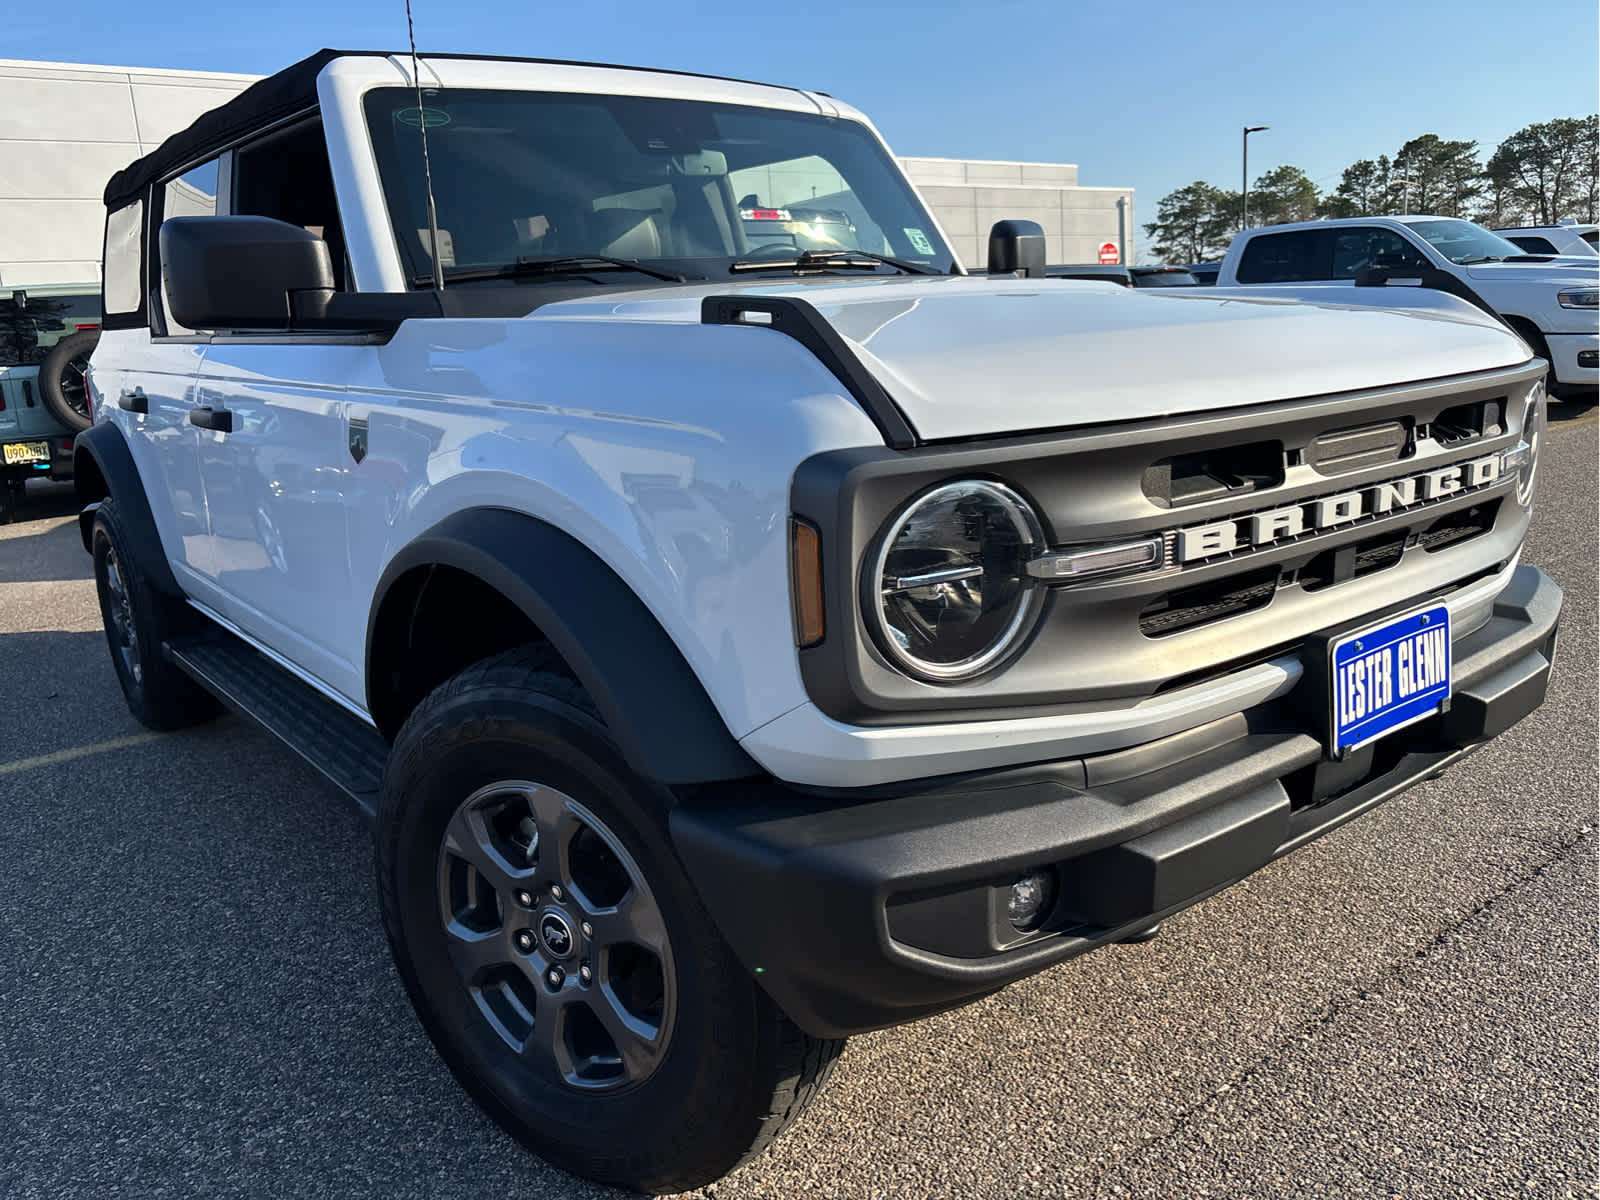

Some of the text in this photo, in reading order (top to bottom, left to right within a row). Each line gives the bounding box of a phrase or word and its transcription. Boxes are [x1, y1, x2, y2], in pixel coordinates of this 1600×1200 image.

[1179, 454, 1501, 562] BRONCO
[1339, 627, 1447, 728] LESTER GLENN
